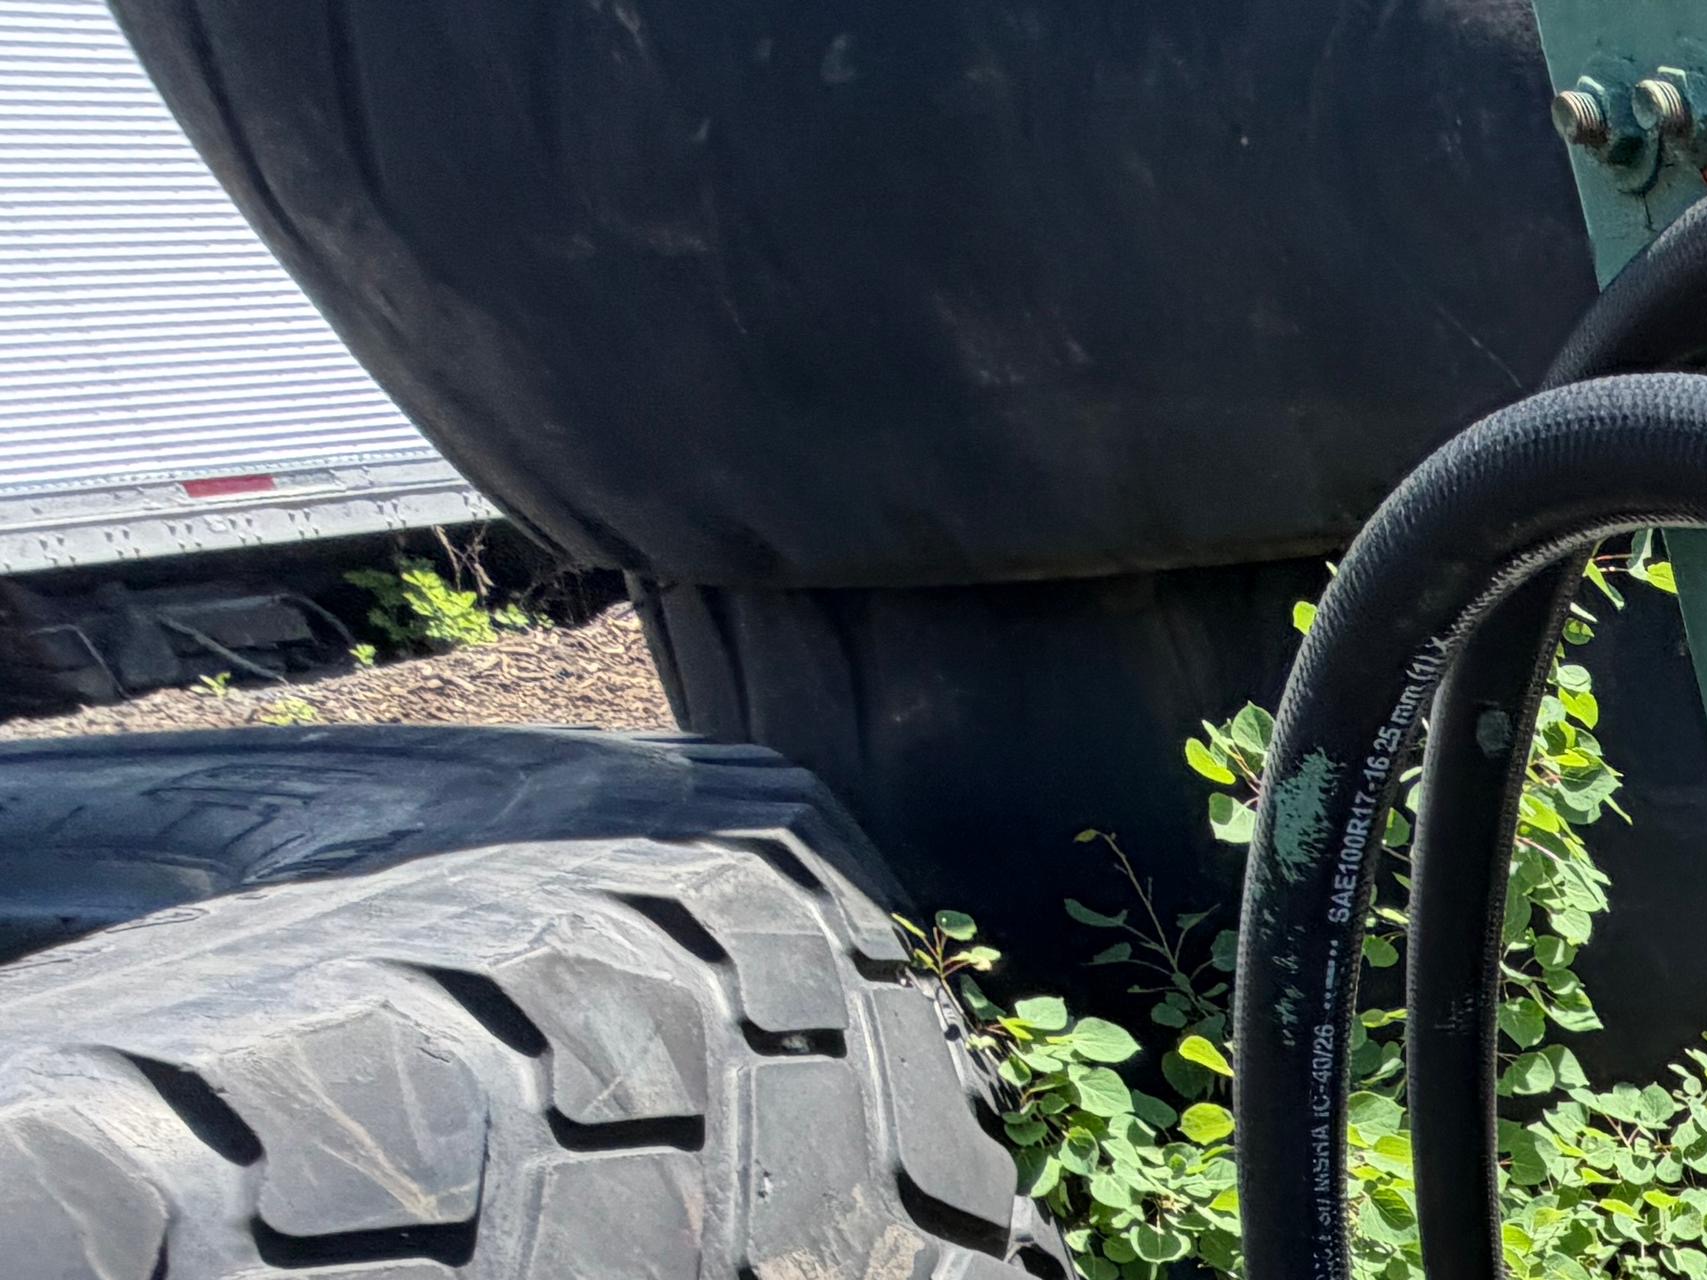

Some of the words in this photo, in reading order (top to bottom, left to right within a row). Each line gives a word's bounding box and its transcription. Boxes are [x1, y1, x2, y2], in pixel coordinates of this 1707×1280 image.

[1328, 754, 1391, 925] SAE100R17-16
[1373, 724, 1401, 753] 25
[1390, 684, 1422, 726] mm
[1311, 1023, 1335, 1117] IC-40/26
[1311, 1122, 1332, 1191] MSHA
